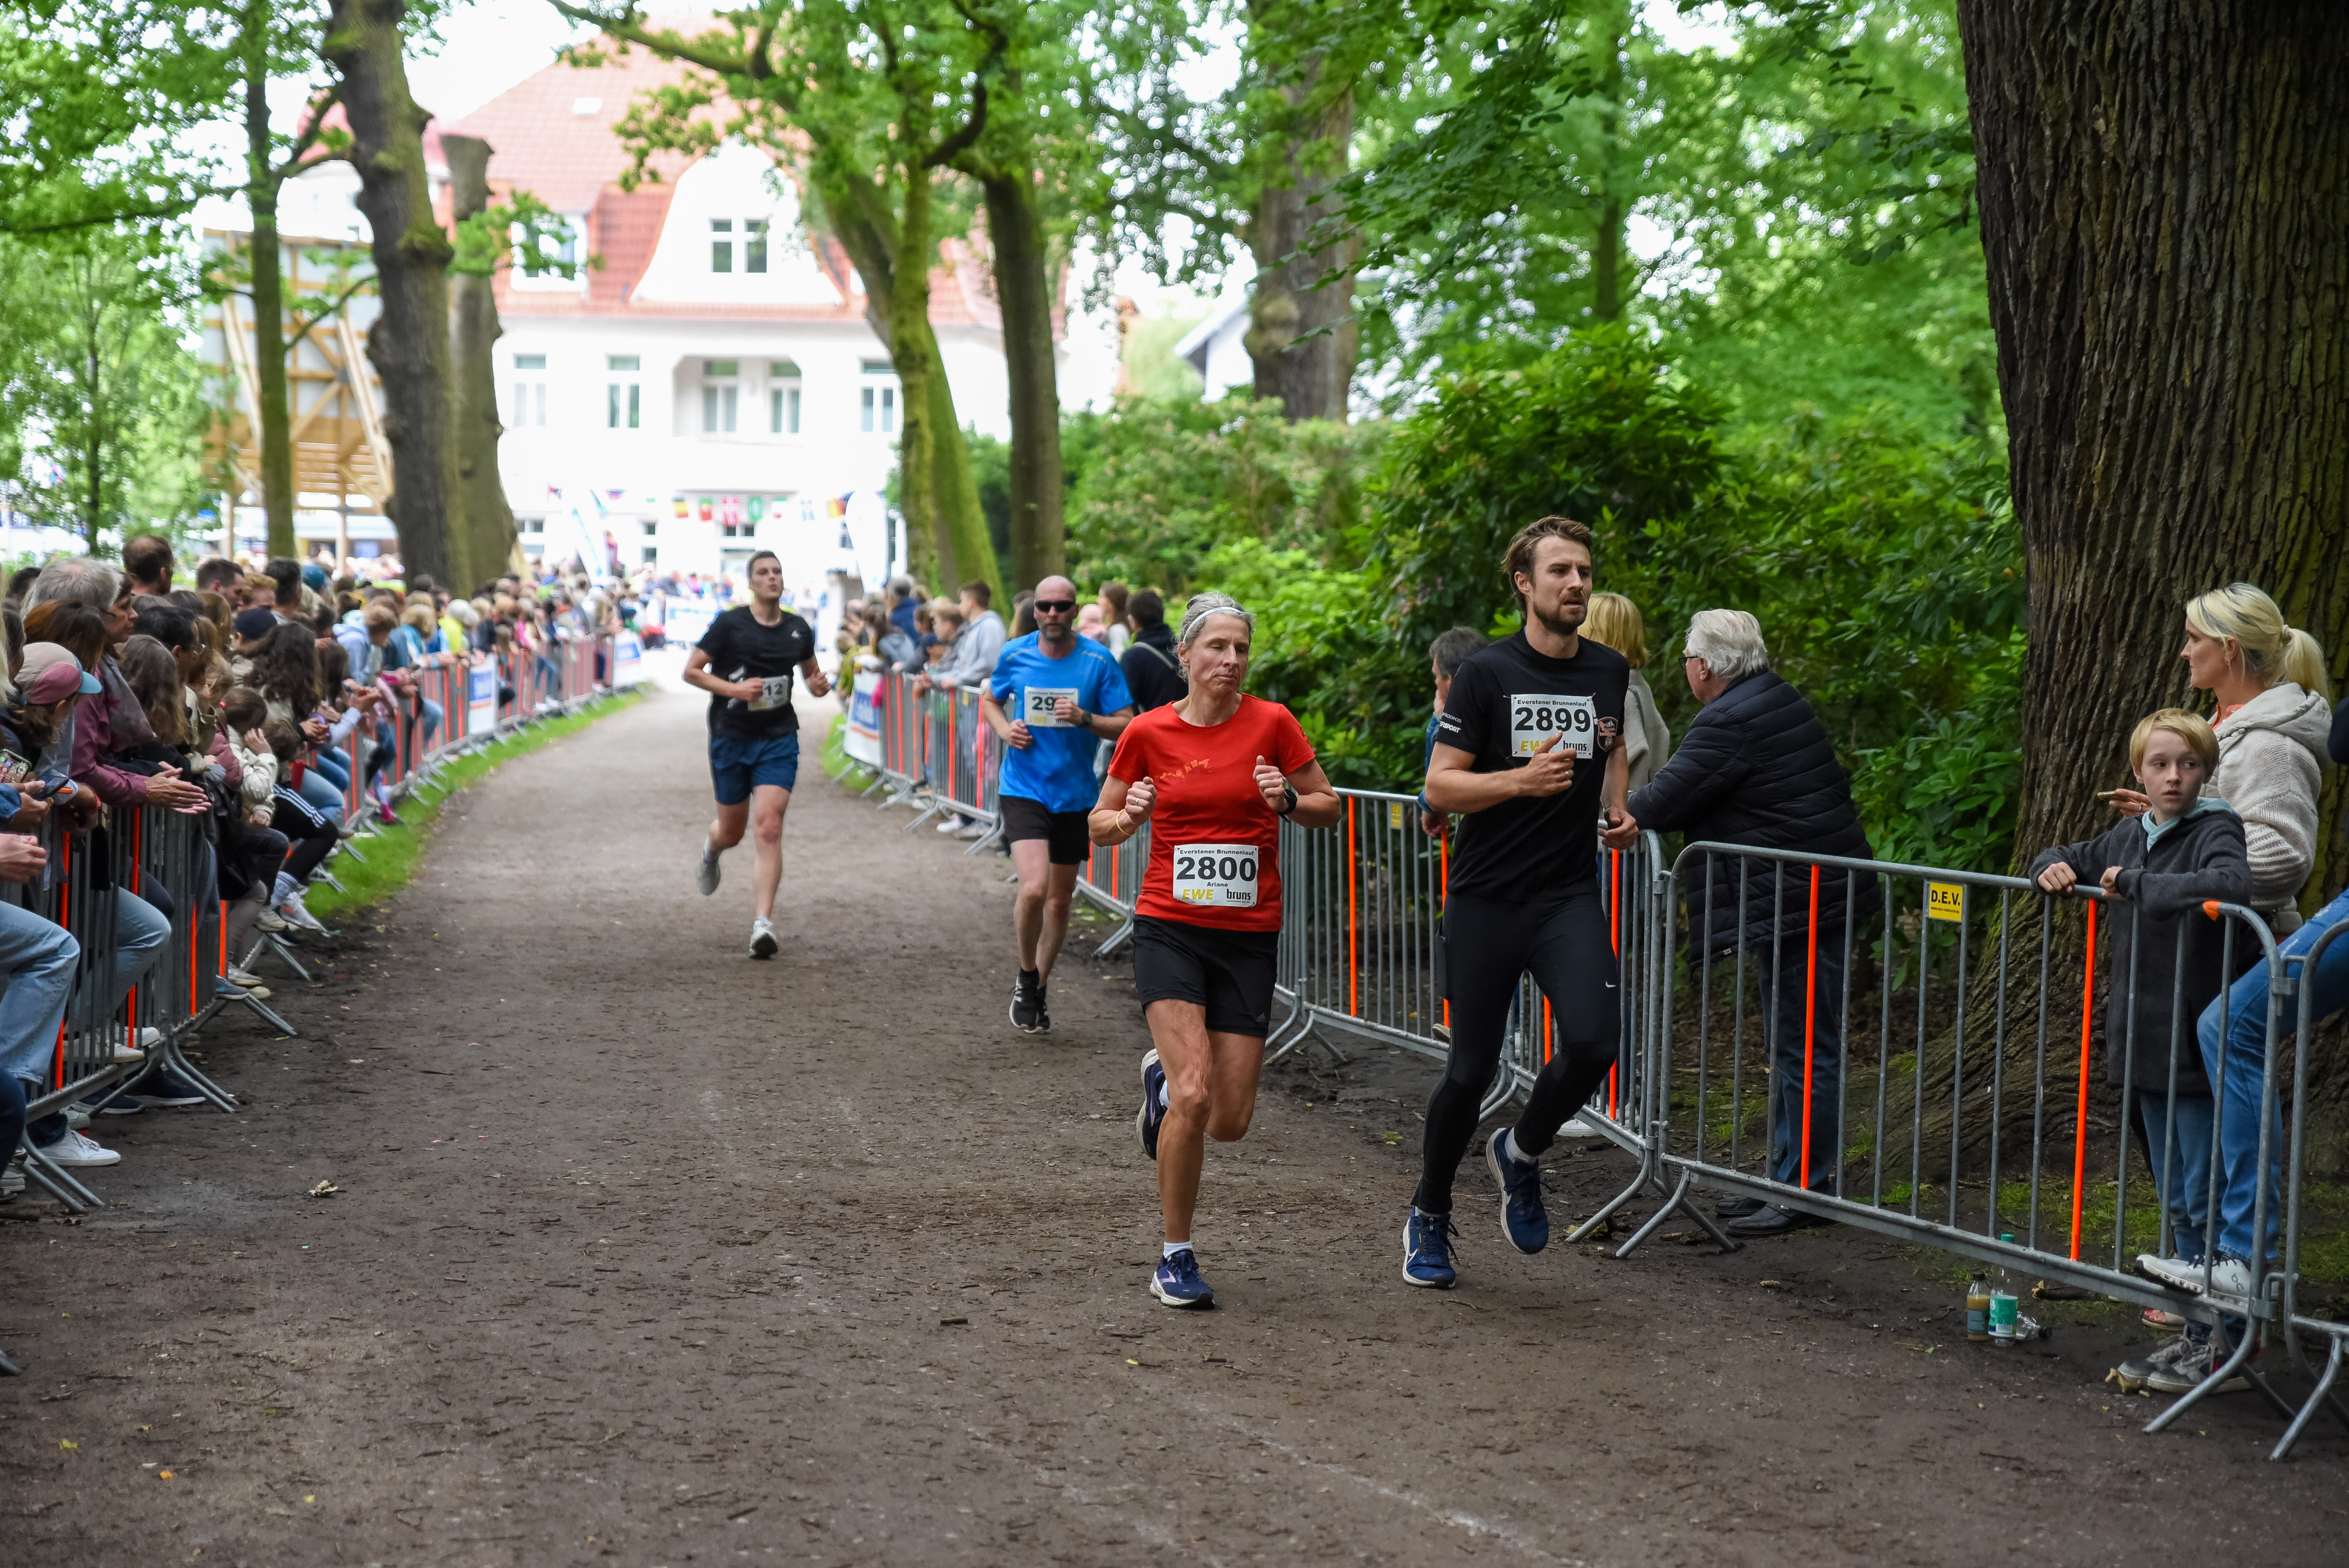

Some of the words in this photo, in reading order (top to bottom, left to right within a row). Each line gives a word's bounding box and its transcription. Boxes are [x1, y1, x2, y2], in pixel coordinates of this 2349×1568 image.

[764, 683, 782, 696] 12
[1031, 696, 1068, 711] 29
[1514, 707, 1591, 732] 2899
[1521, 740, 1550, 752] EW
[1176, 856, 1256, 882] 2800
[1182, 889, 1214, 900] EWE
[1227, 888, 1251, 900] bruns
[1931, 889, 1960, 906] D.E.V.
